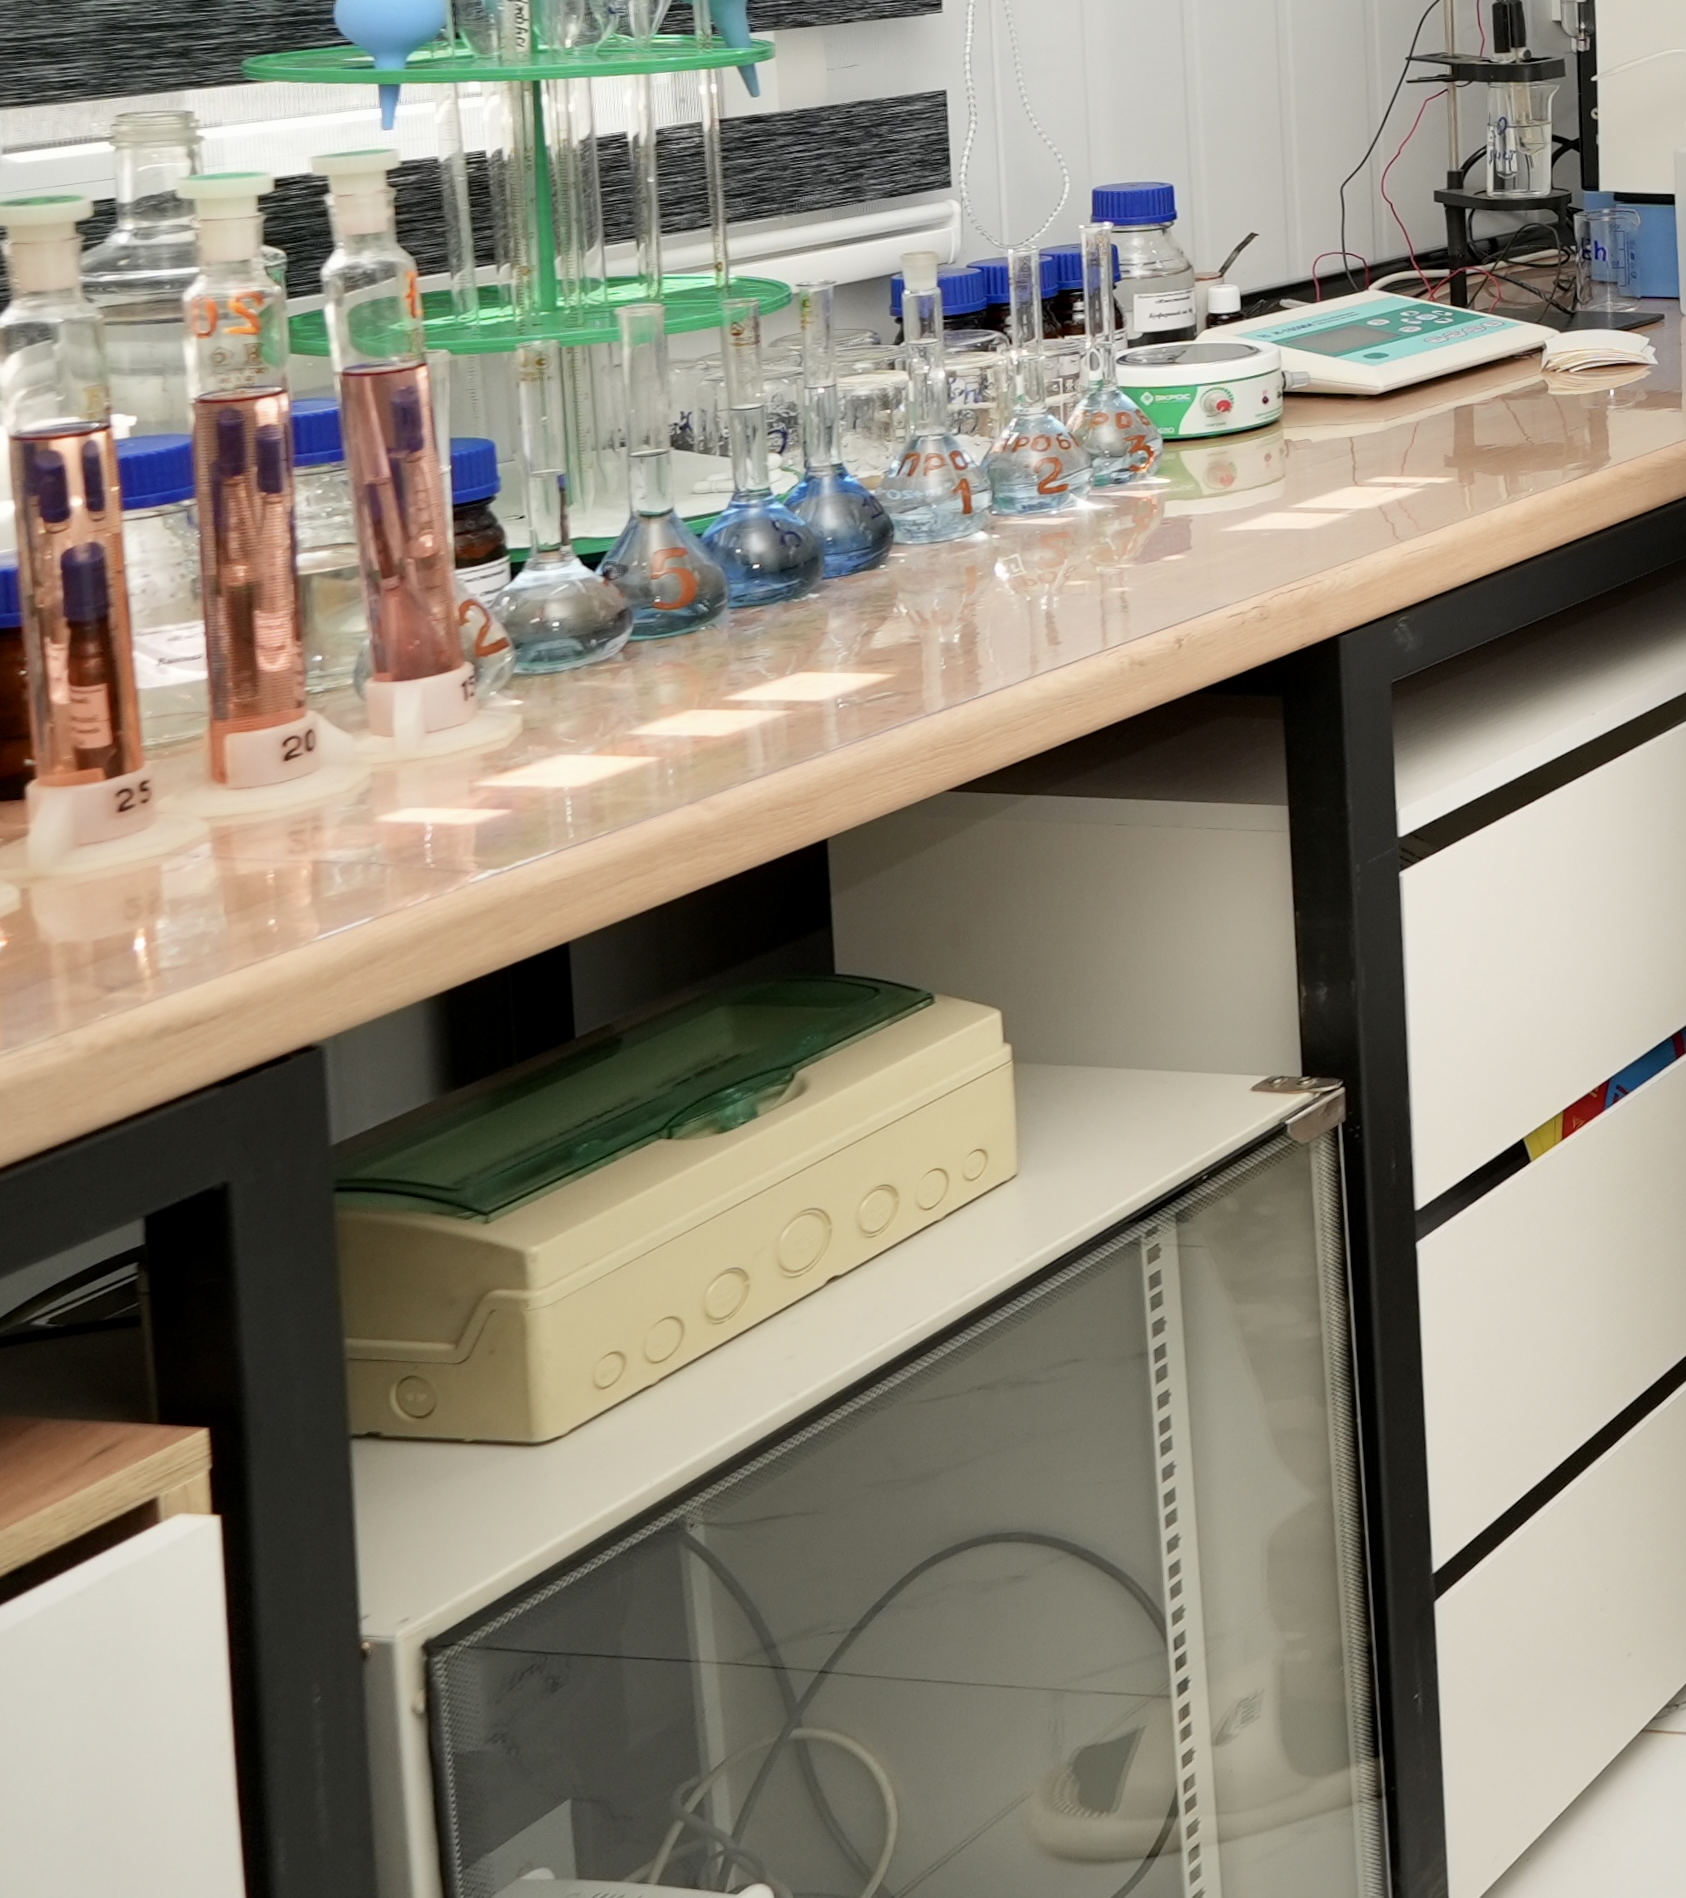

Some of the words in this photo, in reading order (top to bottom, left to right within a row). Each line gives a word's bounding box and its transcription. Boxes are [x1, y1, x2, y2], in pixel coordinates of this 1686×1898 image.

[1123, 434, 1154, 472] 3
[1034, 457, 1069, 495] 2
[952, 477, 974, 515] 1
[650, 546, 699, 611] 5
[458, 598, 510, 658] 2
[281, 728, 317, 763] 20
[114, 778, 153, 814] 25
